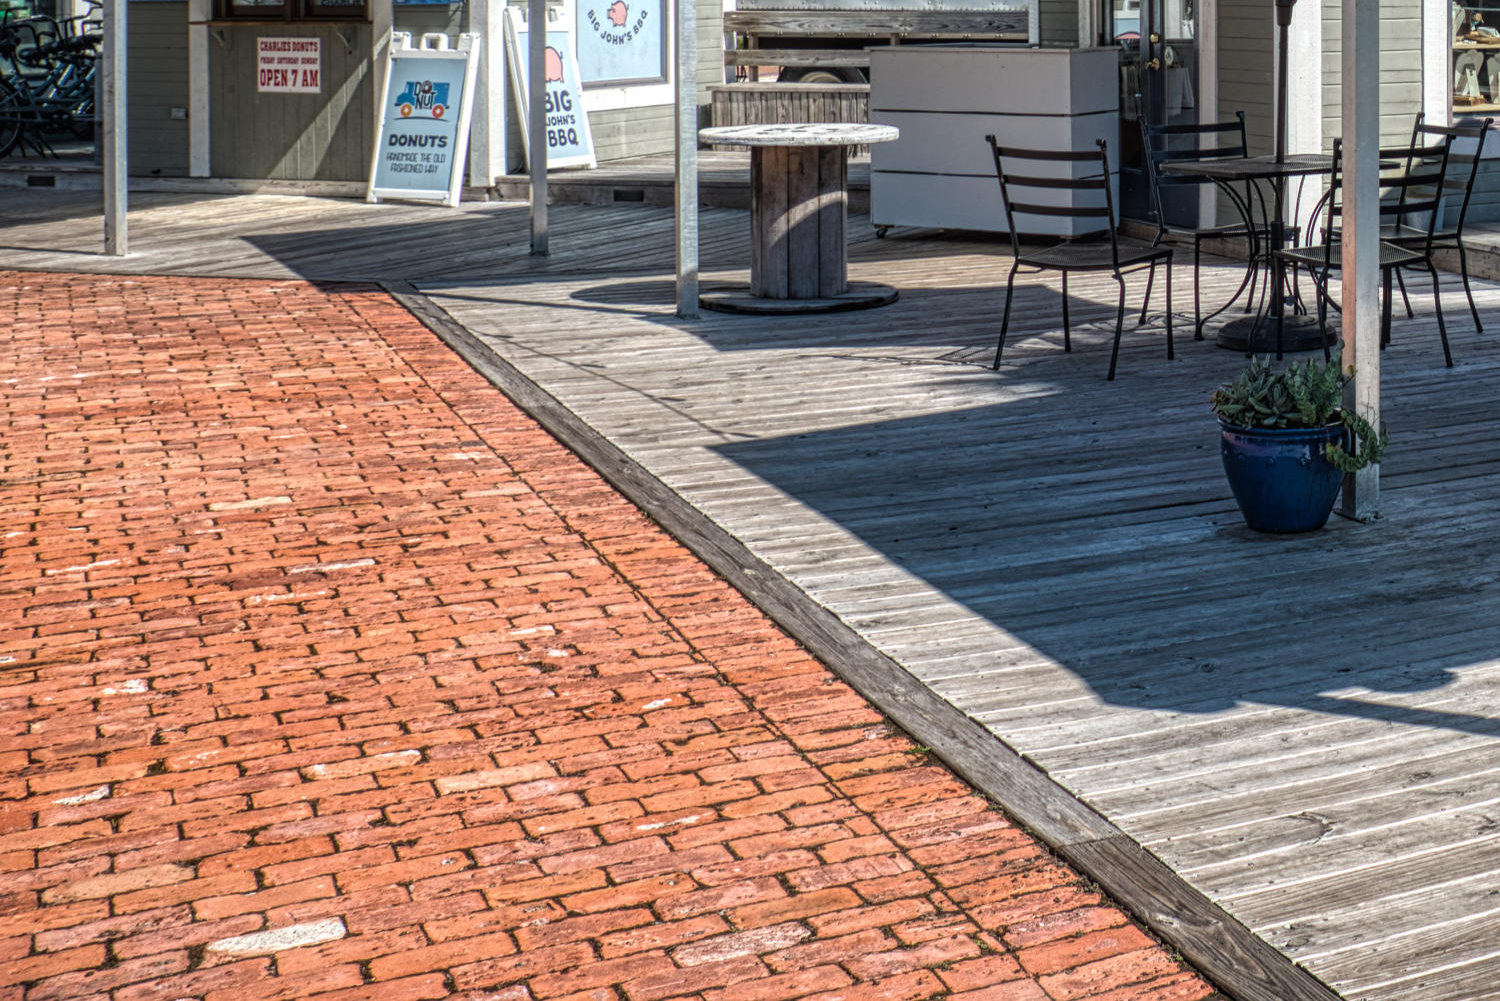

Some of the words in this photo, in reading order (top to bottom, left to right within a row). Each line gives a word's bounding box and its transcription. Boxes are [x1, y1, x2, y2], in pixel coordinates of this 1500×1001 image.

[587, 9, 600, 32] BIG
[600, 31, 633, 45] JOHN'S
[633, 10, 648, 35] BBQ
[292, 41, 318, 52] DONUTS
[260, 68, 288, 87] OPEN
[291, 69, 298, 87] 7
[302, 69, 319, 87] AM
[415, 91, 436, 110] NUT
[388, 134, 448, 148] DONUTS
[547, 127, 578, 148] BBQ
[386, 152, 418, 162] HANDMADE
[420, 153, 431, 163] THE
[433, 154, 446, 163] OLD
[390, 162, 423, 173] FASHIONED
[424, 163, 439, 174] WAY
